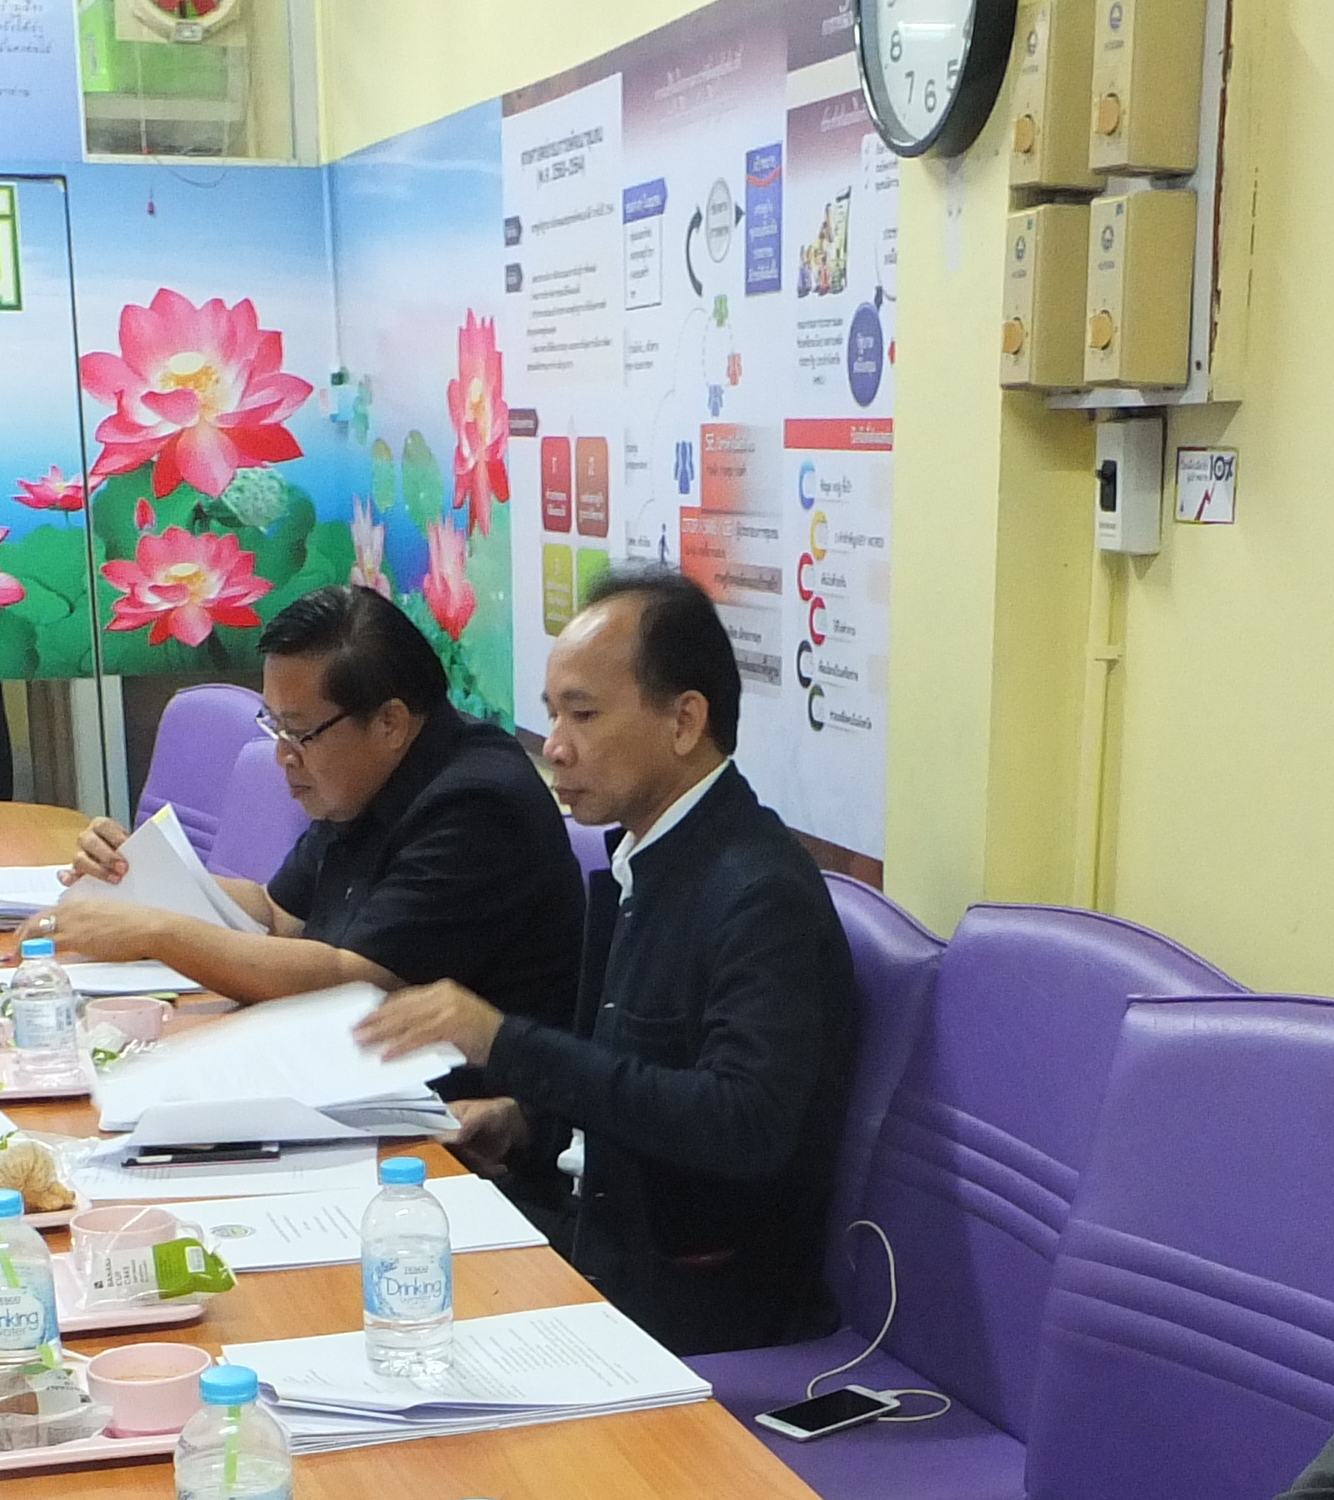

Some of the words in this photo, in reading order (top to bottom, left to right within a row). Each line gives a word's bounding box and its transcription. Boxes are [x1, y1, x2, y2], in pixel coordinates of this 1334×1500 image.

[890, 30, 902, 62] 8
[905, 70, 914, 104] 7
[924, 79, 936, 113] 6
[380, 1276, 442, 1298] Drinking
